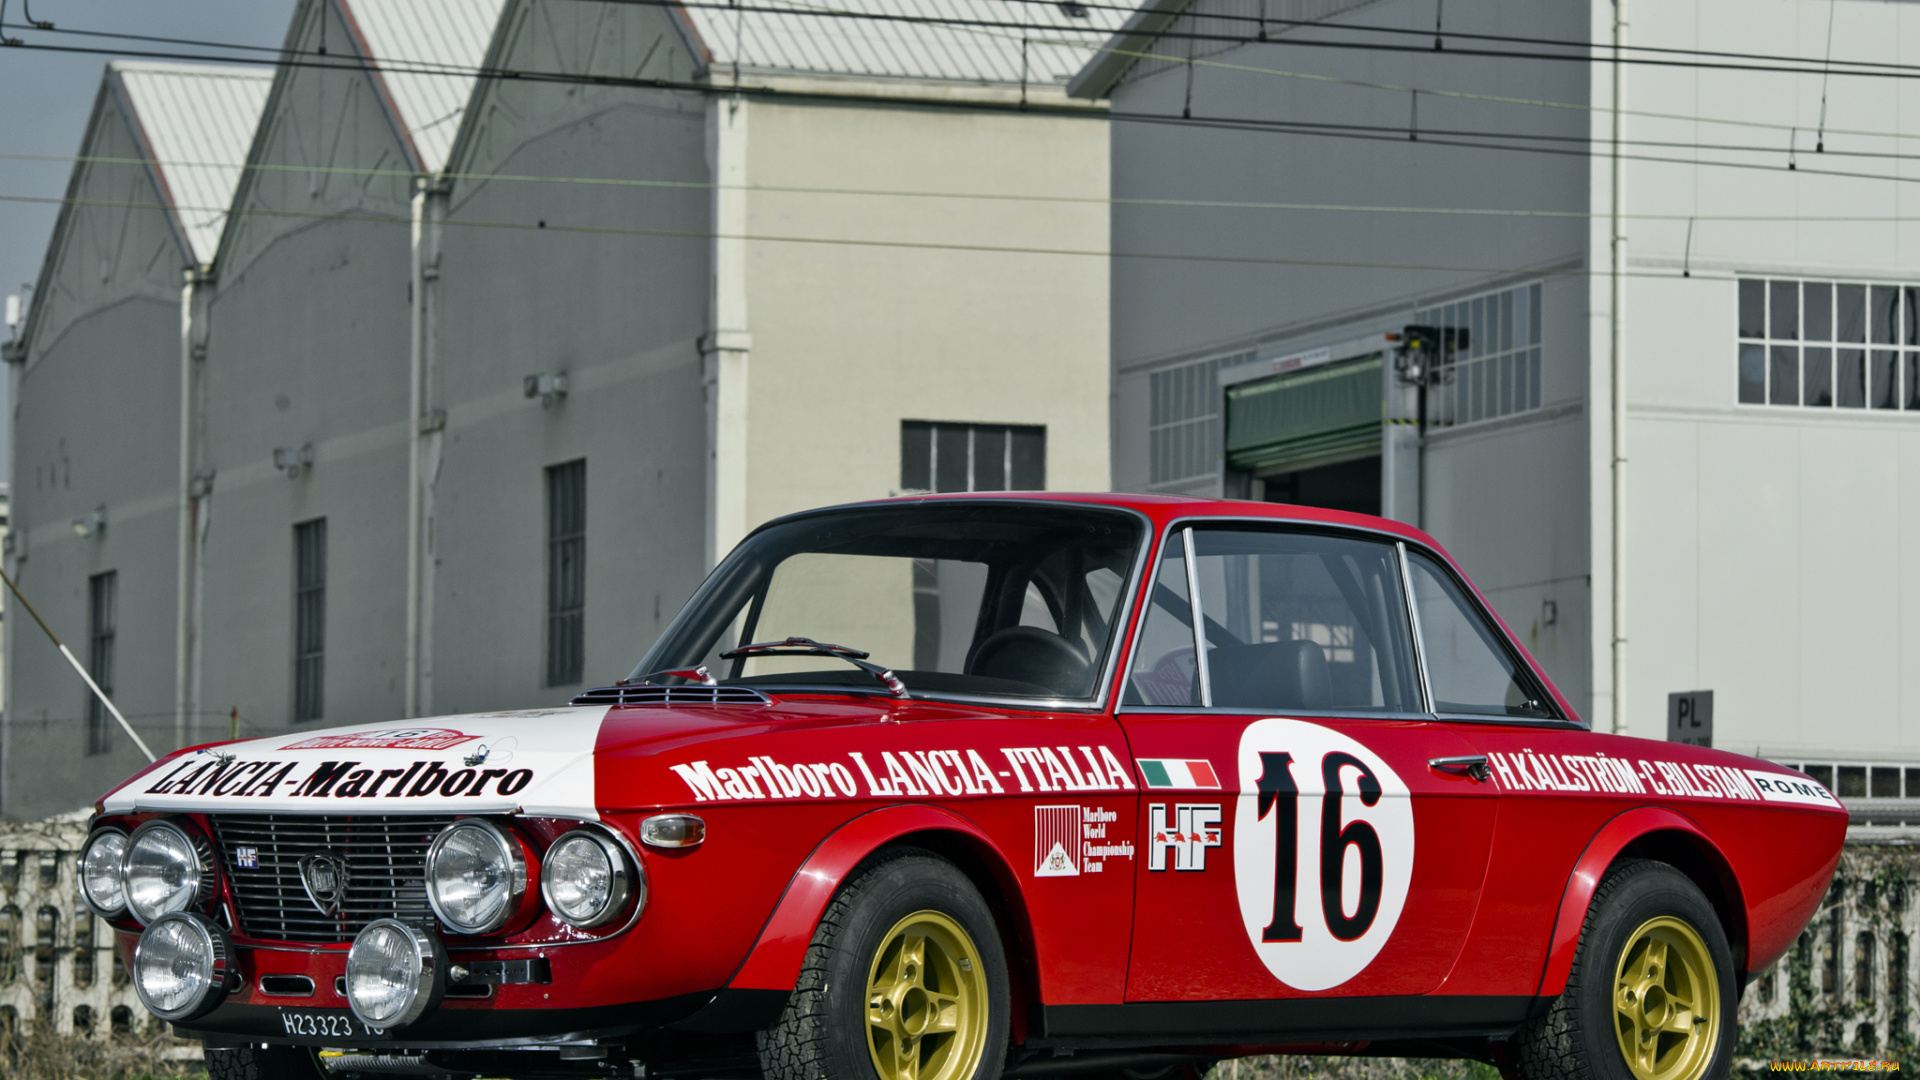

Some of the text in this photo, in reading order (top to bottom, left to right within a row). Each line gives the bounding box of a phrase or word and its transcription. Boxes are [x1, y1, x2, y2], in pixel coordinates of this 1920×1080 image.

[1678, 697, 1702, 729] PL
[669, 746, 1136, 801] Marlboro LANCIA-ITALIA
[1755, 778, 1832, 800] ROME
[1083, 807, 1117, 822] Marlboro
[1083, 824, 1106, 839] World
[1148, 803, 1223, 873] HF
[236, 847, 257, 867] HF
[1083, 841, 1135, 860] Championship
[1255, 751, 1383, 943] 16
[1083, 858, 1103, 873] Team
[282, 1013, 352, 1036] H23323
